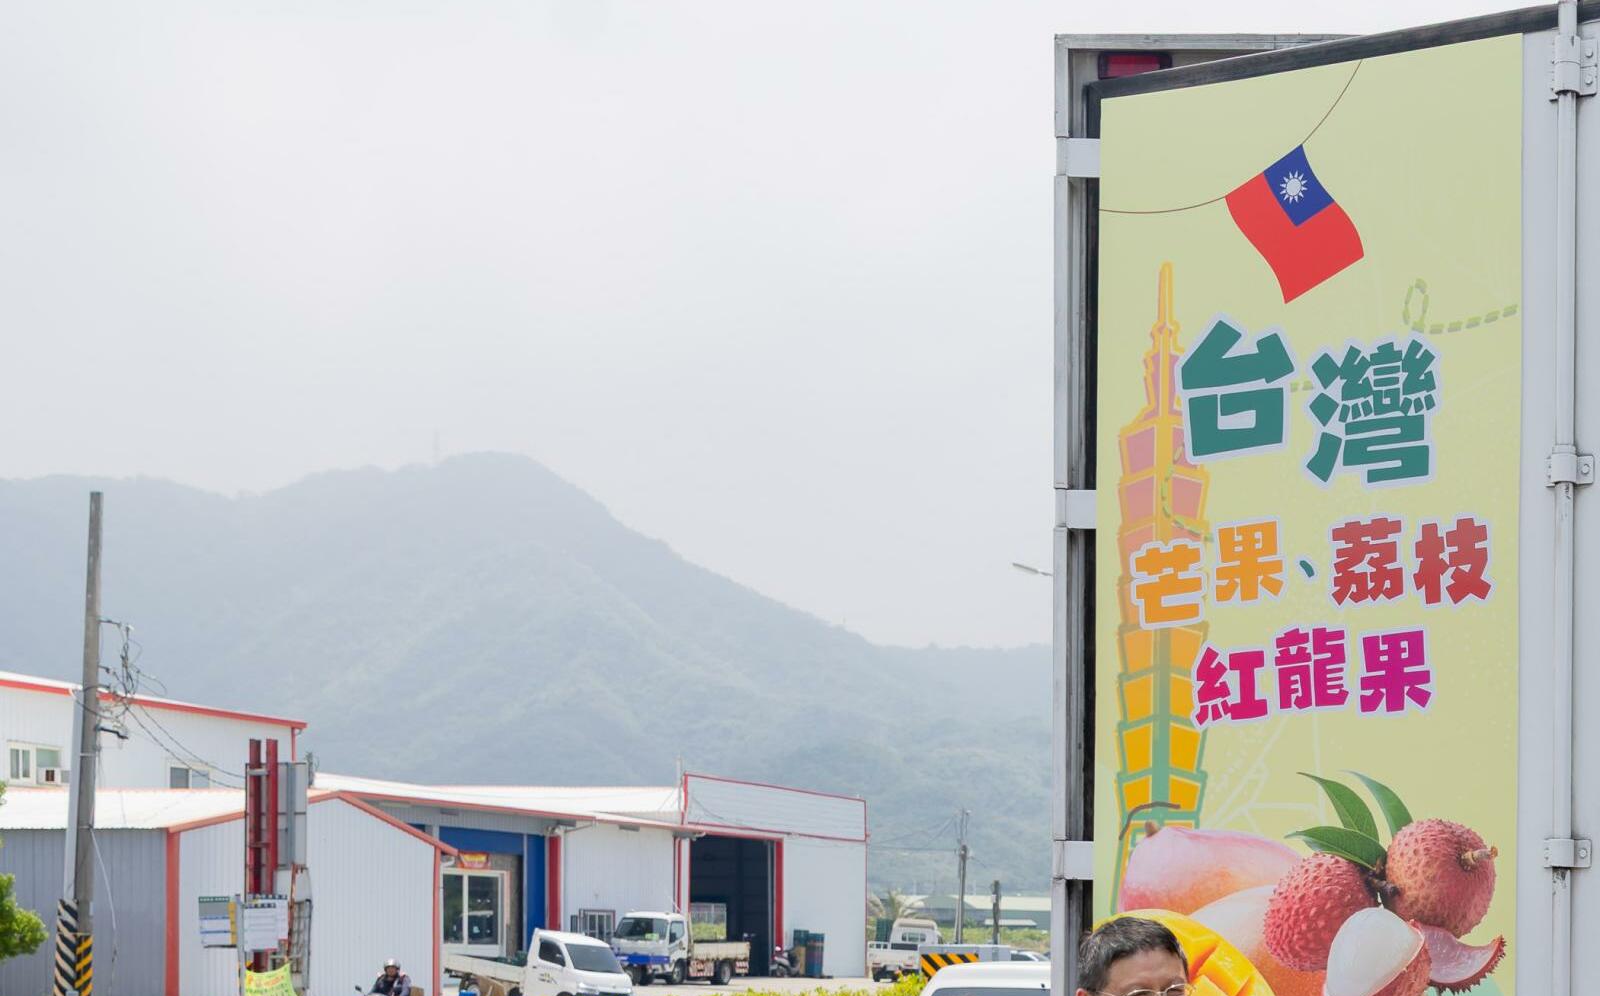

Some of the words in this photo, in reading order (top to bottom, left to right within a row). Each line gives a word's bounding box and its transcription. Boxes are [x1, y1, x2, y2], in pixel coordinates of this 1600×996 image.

[1181, 320, 1437, 484] 台灣
[1135, 516, 1492, 625] 芒果、荔枝
[1195, 627, 1432, 726] 紅龍果
